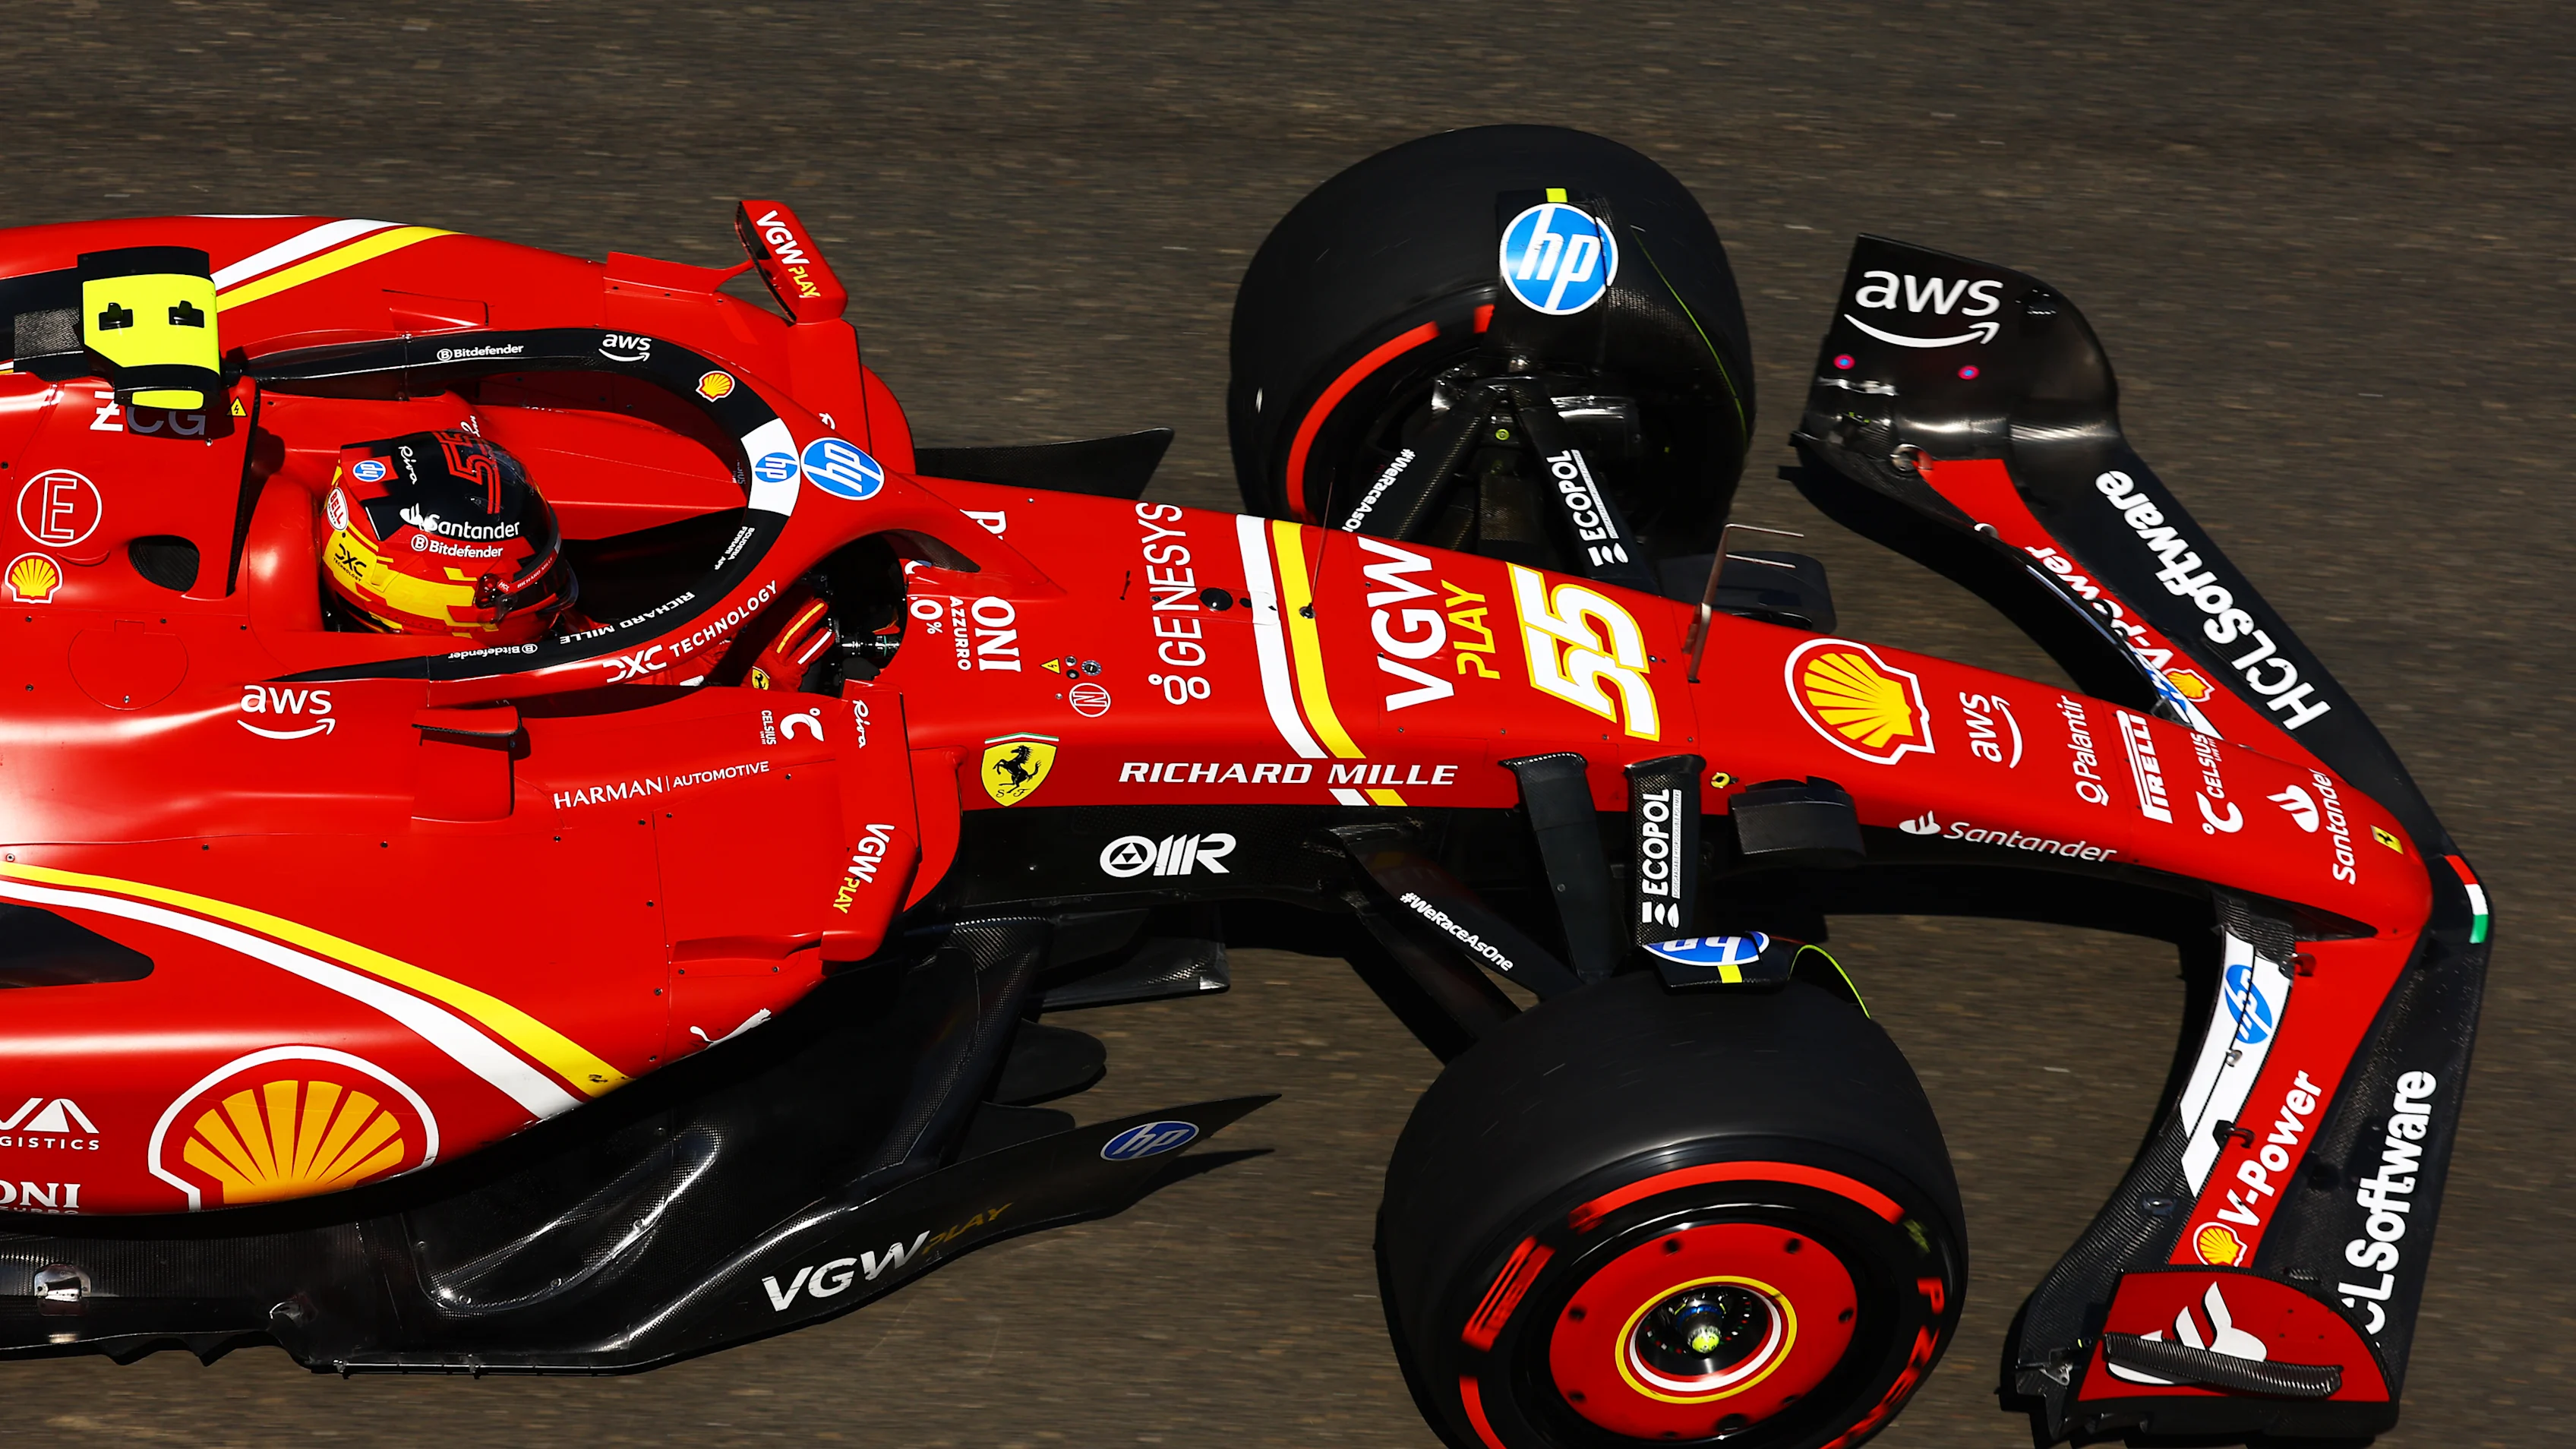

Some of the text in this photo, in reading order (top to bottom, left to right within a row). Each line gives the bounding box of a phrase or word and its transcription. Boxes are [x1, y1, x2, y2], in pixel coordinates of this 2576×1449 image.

[756, 210, 821, 297] VGW PLAY
[1514, 204, 1606, 312] hp
[1855, 270, 2004, 317] aws
[453, 345, 524, 358] Bitdefender
[602, 333, 652, 352] aws
[354, 463, 385, 478] hp
[398, 446, 418, 485] Riva
[755, 456, 797, 480] hp
[800, 442, 882, 494] hp
[1342, 449, 1416, 532] #WeRaceAsO
[1546, 450, 1607, 541] ECOPOL
[41, 478, 77, 539] E
[330, 491, 343, 525] BELL
[424, 513, 519, 540] Santander
[333, 557, 361, 582] TECHNOLOGY
[334, 543, 367, 577] DXC
[429, 540, 504, 558] Bitdefender
[1135, 502, 1207, 667] GENESYS
[2096, 471, 2330, 729] HCLSoftware
[560, 592, 695, 645] RICHARD MILLE
[602, 580, 778, 683] DXC TECHNOLOGY
[949, 595, 971, 671] AZZURRO
[1358, 536, 1454, 712] VGW
[1441, 579, 1501, 680] PLAY
[448, 646, 520, 659] Bitdefender
[1506, 561, 1661, 742] 55
[241, 685, 332, 715] aws
[761, 710, 777, 745] CELSIUS
[852, 699, 871, 749] Riva
[1959, 692, 2003, 762] aws
[2056, 695, 2101, 781] Palantir
[2116, 709, 2174, 824] PIRELLI
[2189, 732, 2225, 799] CELSIUS
[553, 761, 770, 809] HARMAN AUTOMOTIVE
[1119, 762, 1458, 785] RICHARD MILLE
[1642, 788, 1670, 896] ECOPOL
[1944, 821, 2117, 863] Santander
[2307, 767, 2357, 886] Santander
[832, 824, 895, 914] VGW PLAY
[1400, 892, 1514, 971] #WeRaceAsOne
[1118, 1123, 1189, 1158] hp
[2216, 1070, 2323, 1227] V-Power
[2337, 1070, 2438, 1350] CLSoftware
[762, 1201, 1014, 1312] VGW PLAY
